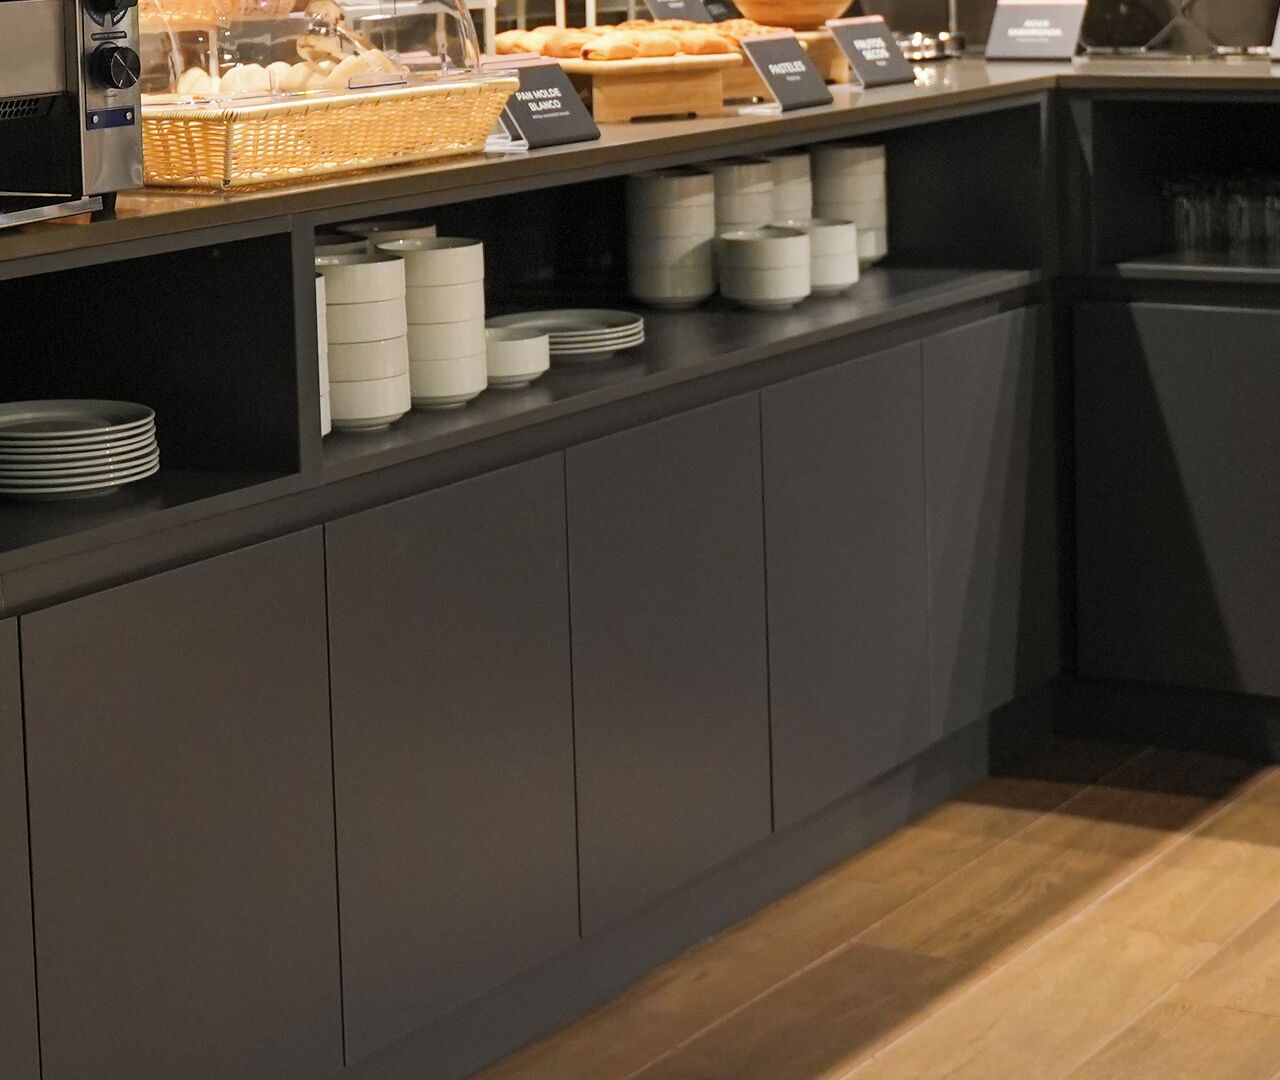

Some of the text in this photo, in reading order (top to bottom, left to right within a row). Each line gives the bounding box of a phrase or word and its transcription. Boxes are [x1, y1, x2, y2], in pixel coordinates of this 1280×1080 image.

[768, 60, 806, 75] PASTELES
[515, 87, 562, 101] PAN MOLDE
[528, 99, 561, 112] BLANCO
